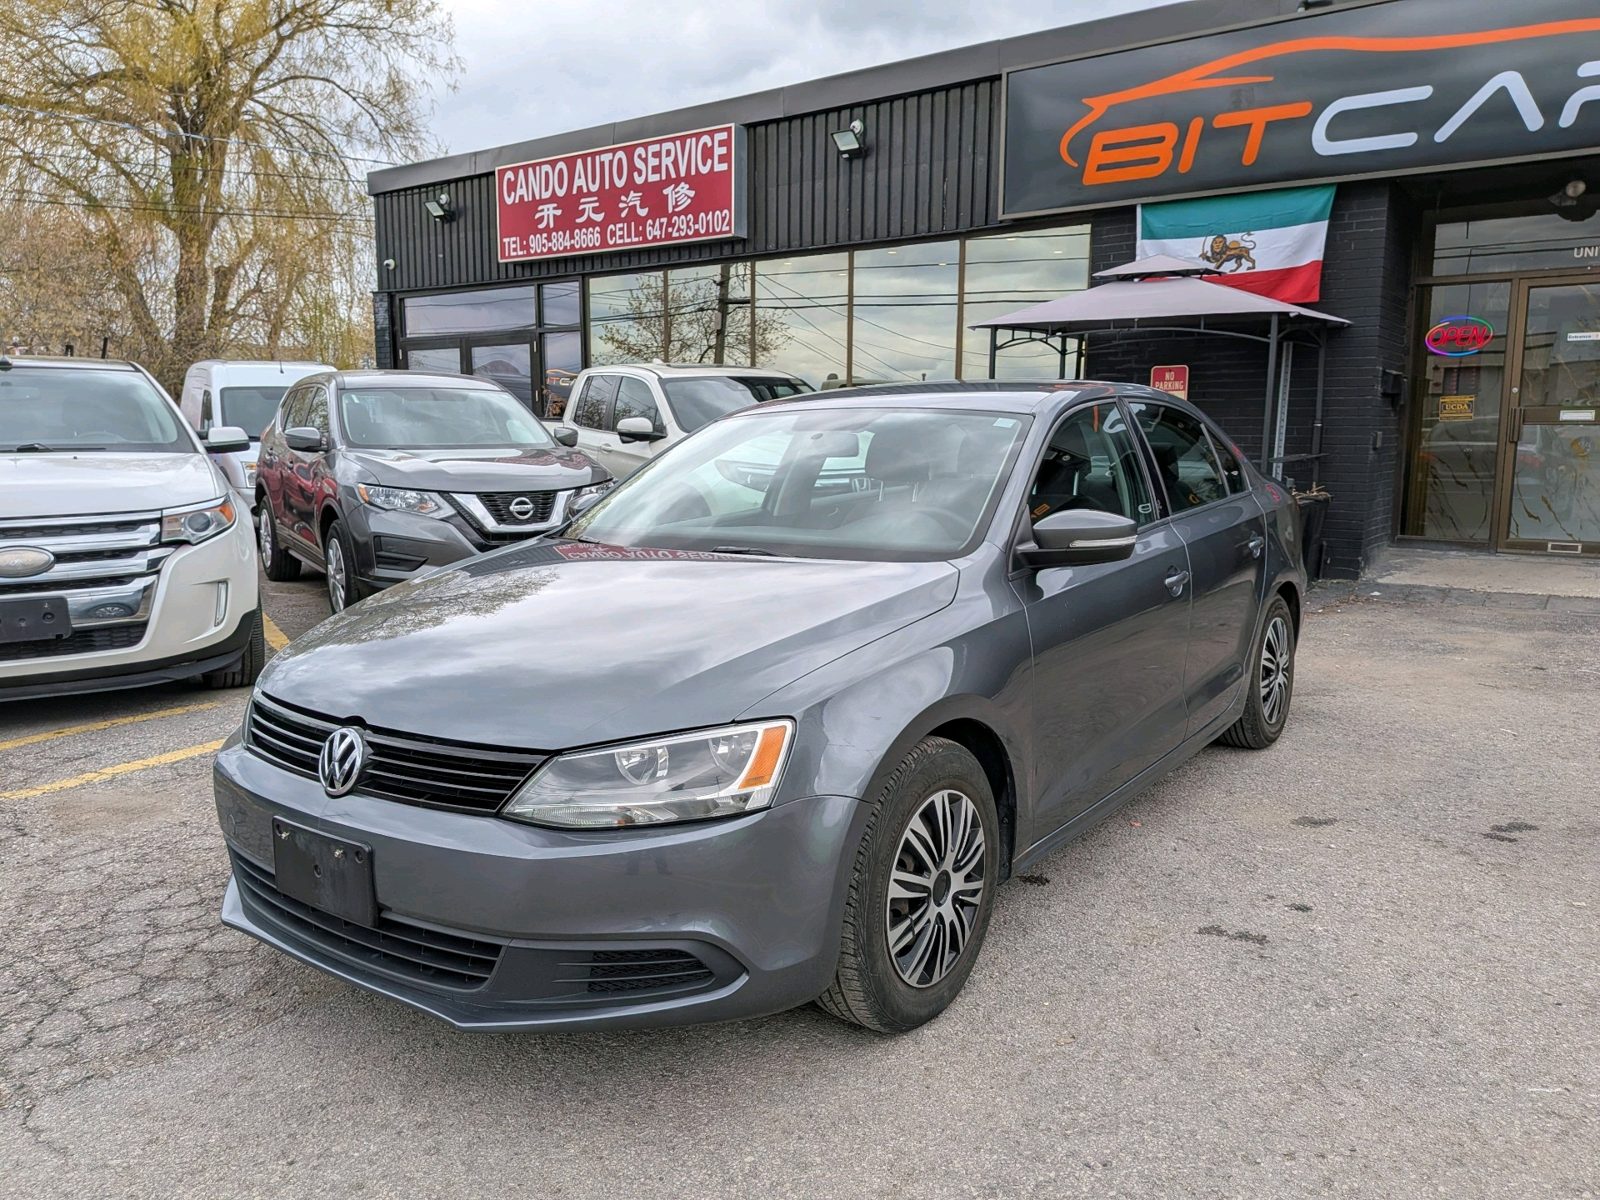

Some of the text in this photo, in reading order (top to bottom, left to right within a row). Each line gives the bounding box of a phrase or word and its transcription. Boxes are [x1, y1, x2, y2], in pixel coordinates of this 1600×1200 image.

[503, 132, 728, 205] CANDO AUTO SERVICE
[503, 209, 730, 257] TEL: 905-884-8666 CELL: 647-293-0102
[1428, 325, 1488, 348] OPEN
[1155, 381, 1184, 390] PARKING
[1164, 371, 1175, 381] NO
